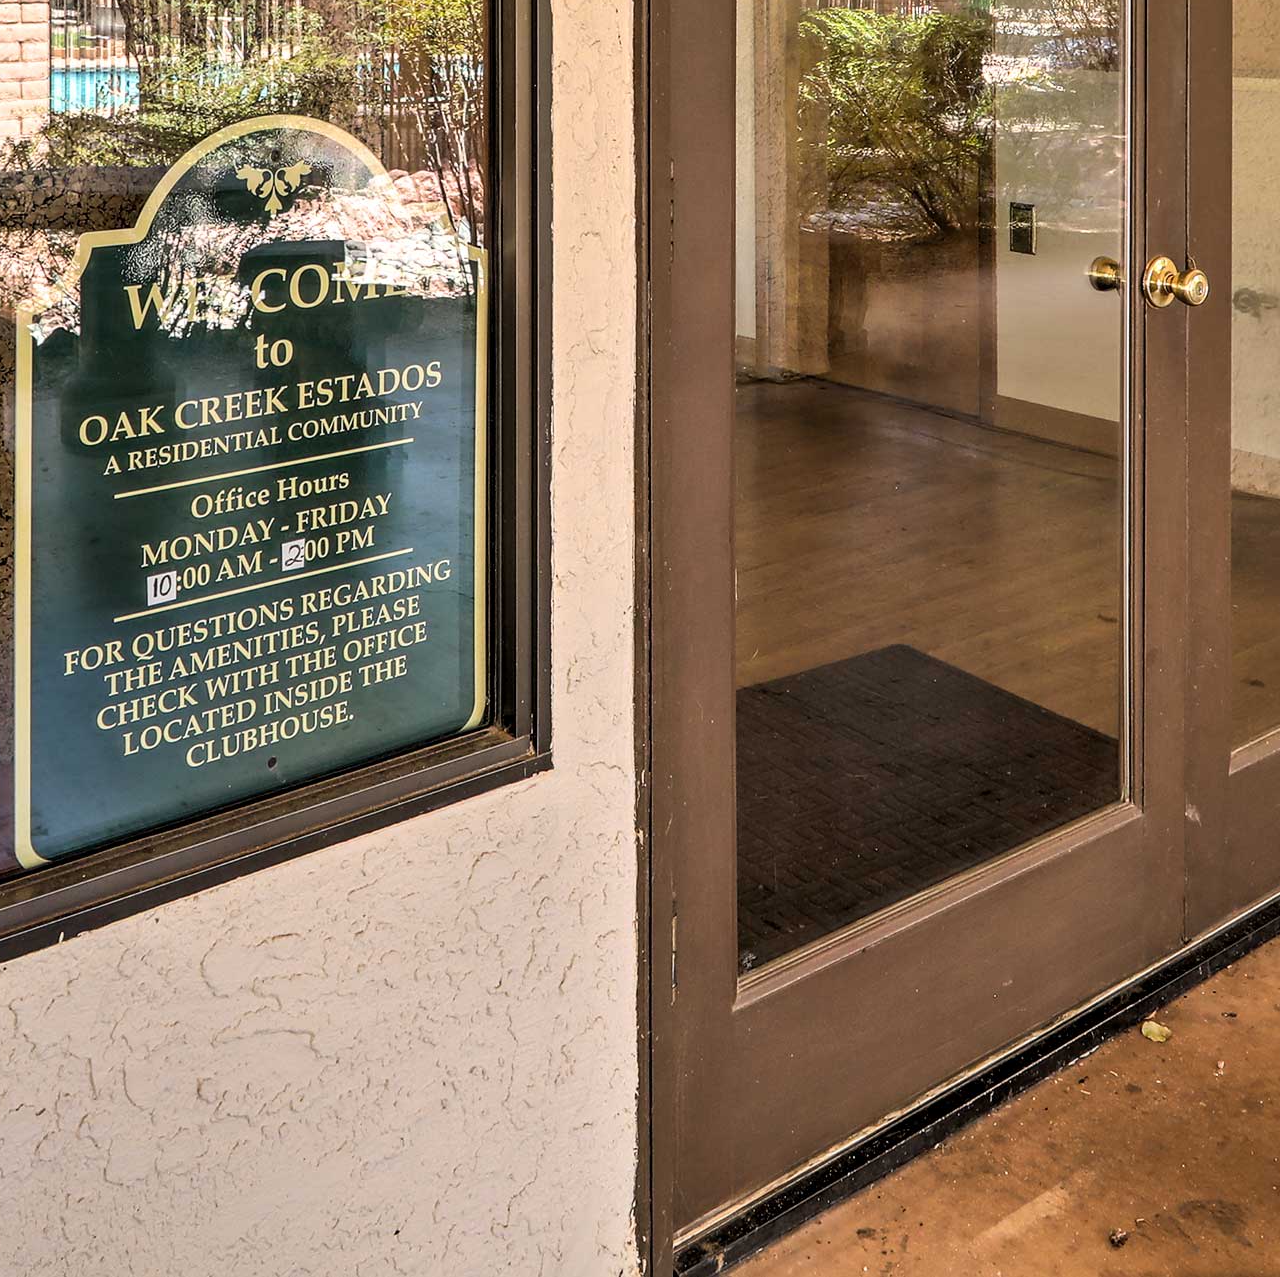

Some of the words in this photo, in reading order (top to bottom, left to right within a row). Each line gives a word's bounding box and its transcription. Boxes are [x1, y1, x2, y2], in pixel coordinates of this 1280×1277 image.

[254, 333, 294, 369] to
[79, 406, 164, 448] OAK
[175, 386, 288, 431] CREEK
[298, 361, 440, 410] ESTADOS
[103, 453, 121, 476] A
[128, 426, 282, 471] RESIDENTIAL
[288, 402, 421, 442] COMMUNITY
[141, 518, 273, 568] MONDAY
[296, 494, 390, 536] FRIDAY
[191, 487, 269, 519] Office
[277, 471, 348, 502] Hours
[215, 550, 263, 583] AM
[336, 525, 376, 555] PM
[64, 638, 124, 675] FOR
[132, 597, 293, 665] QUESTIONS
[300, 560, 450, 618] REGARDING
[104, 659, 162, 698] THE
[168, 623, 325, 681] AMENITIES,
[332, 595, 419, 639] PLEASE
[97, 680, 197, 732] CHECK
[204, 660, 278, 703] WITH
[285, 645, 336, 682] THE
[343, 622, 426, 666] OFFICE
[123, 697, 256, 756] LOCATED
[264, 671, 352, 717] INSIDE
[359, 656, 407, 690] THE
[186, 706, 353, 769] CLUBHOUSE.
